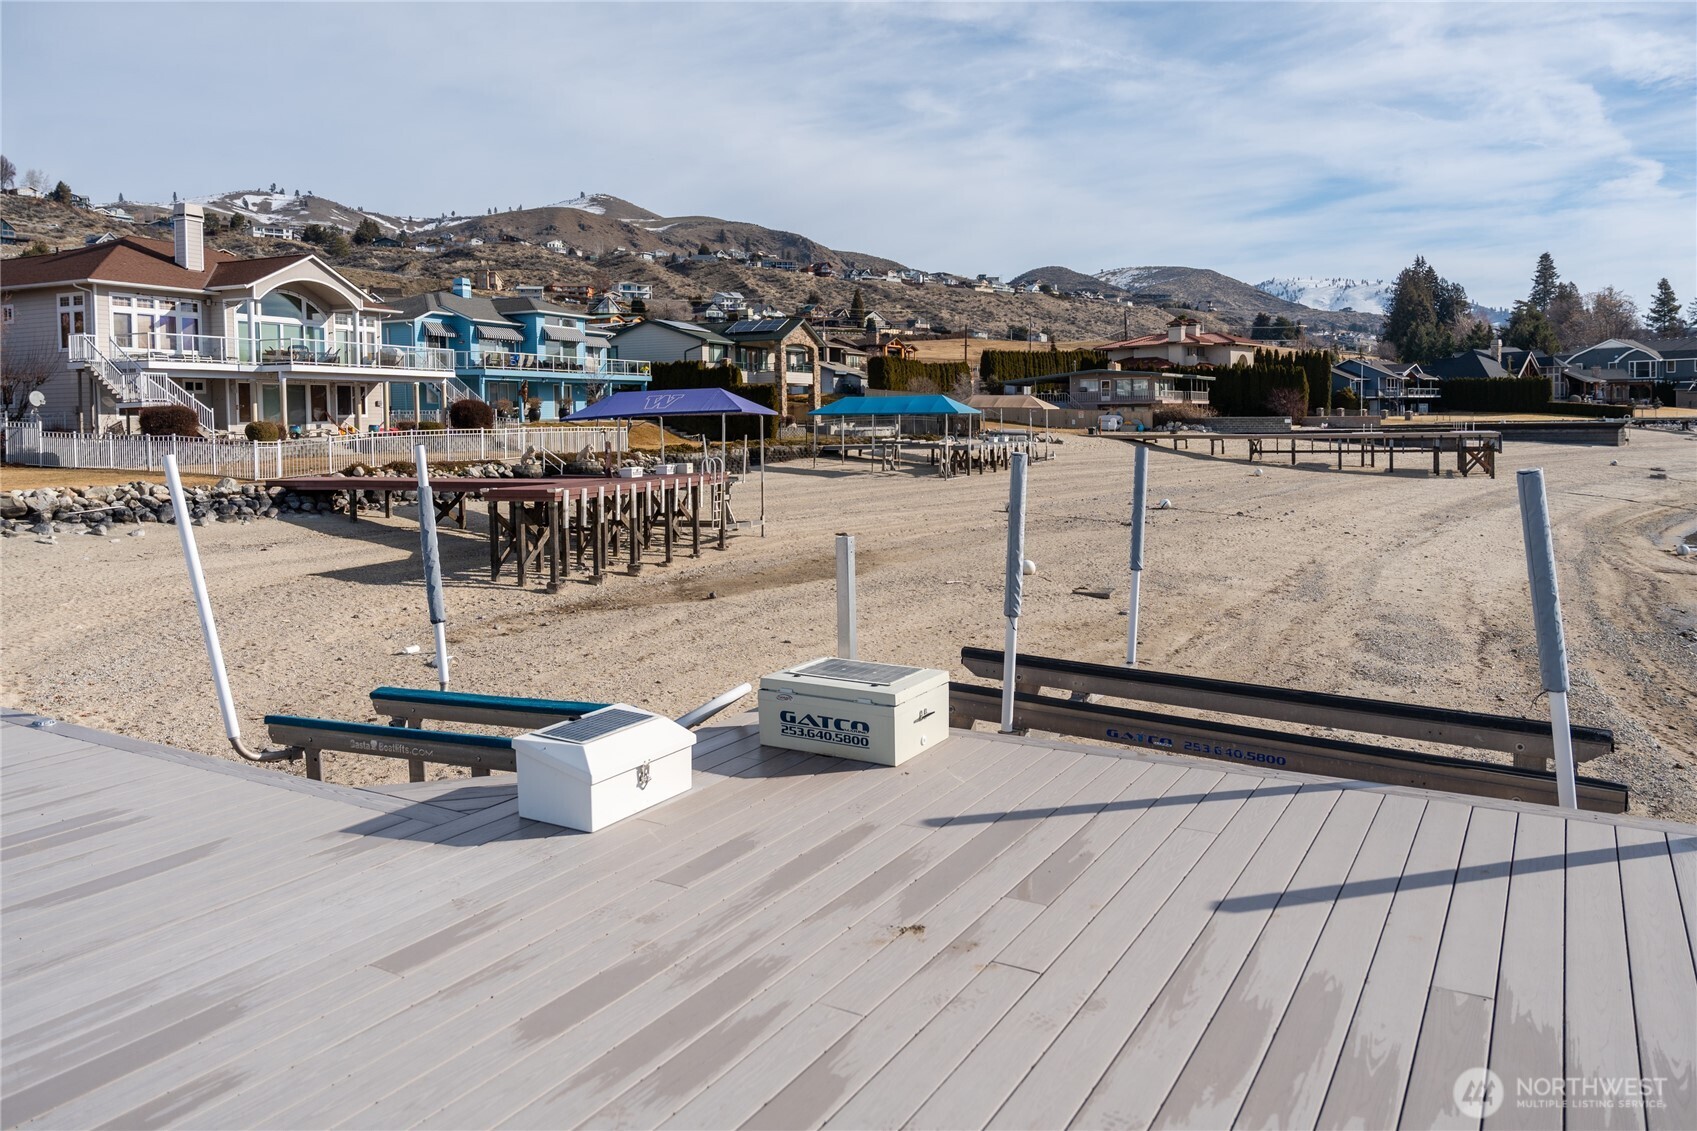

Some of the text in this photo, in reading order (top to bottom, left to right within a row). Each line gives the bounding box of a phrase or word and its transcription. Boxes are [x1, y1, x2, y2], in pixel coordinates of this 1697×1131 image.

[643, 393, 685, 410] W
[780, 710, 870, 734] GATCO
[780, 724, 869, 747] 253.640.5800
